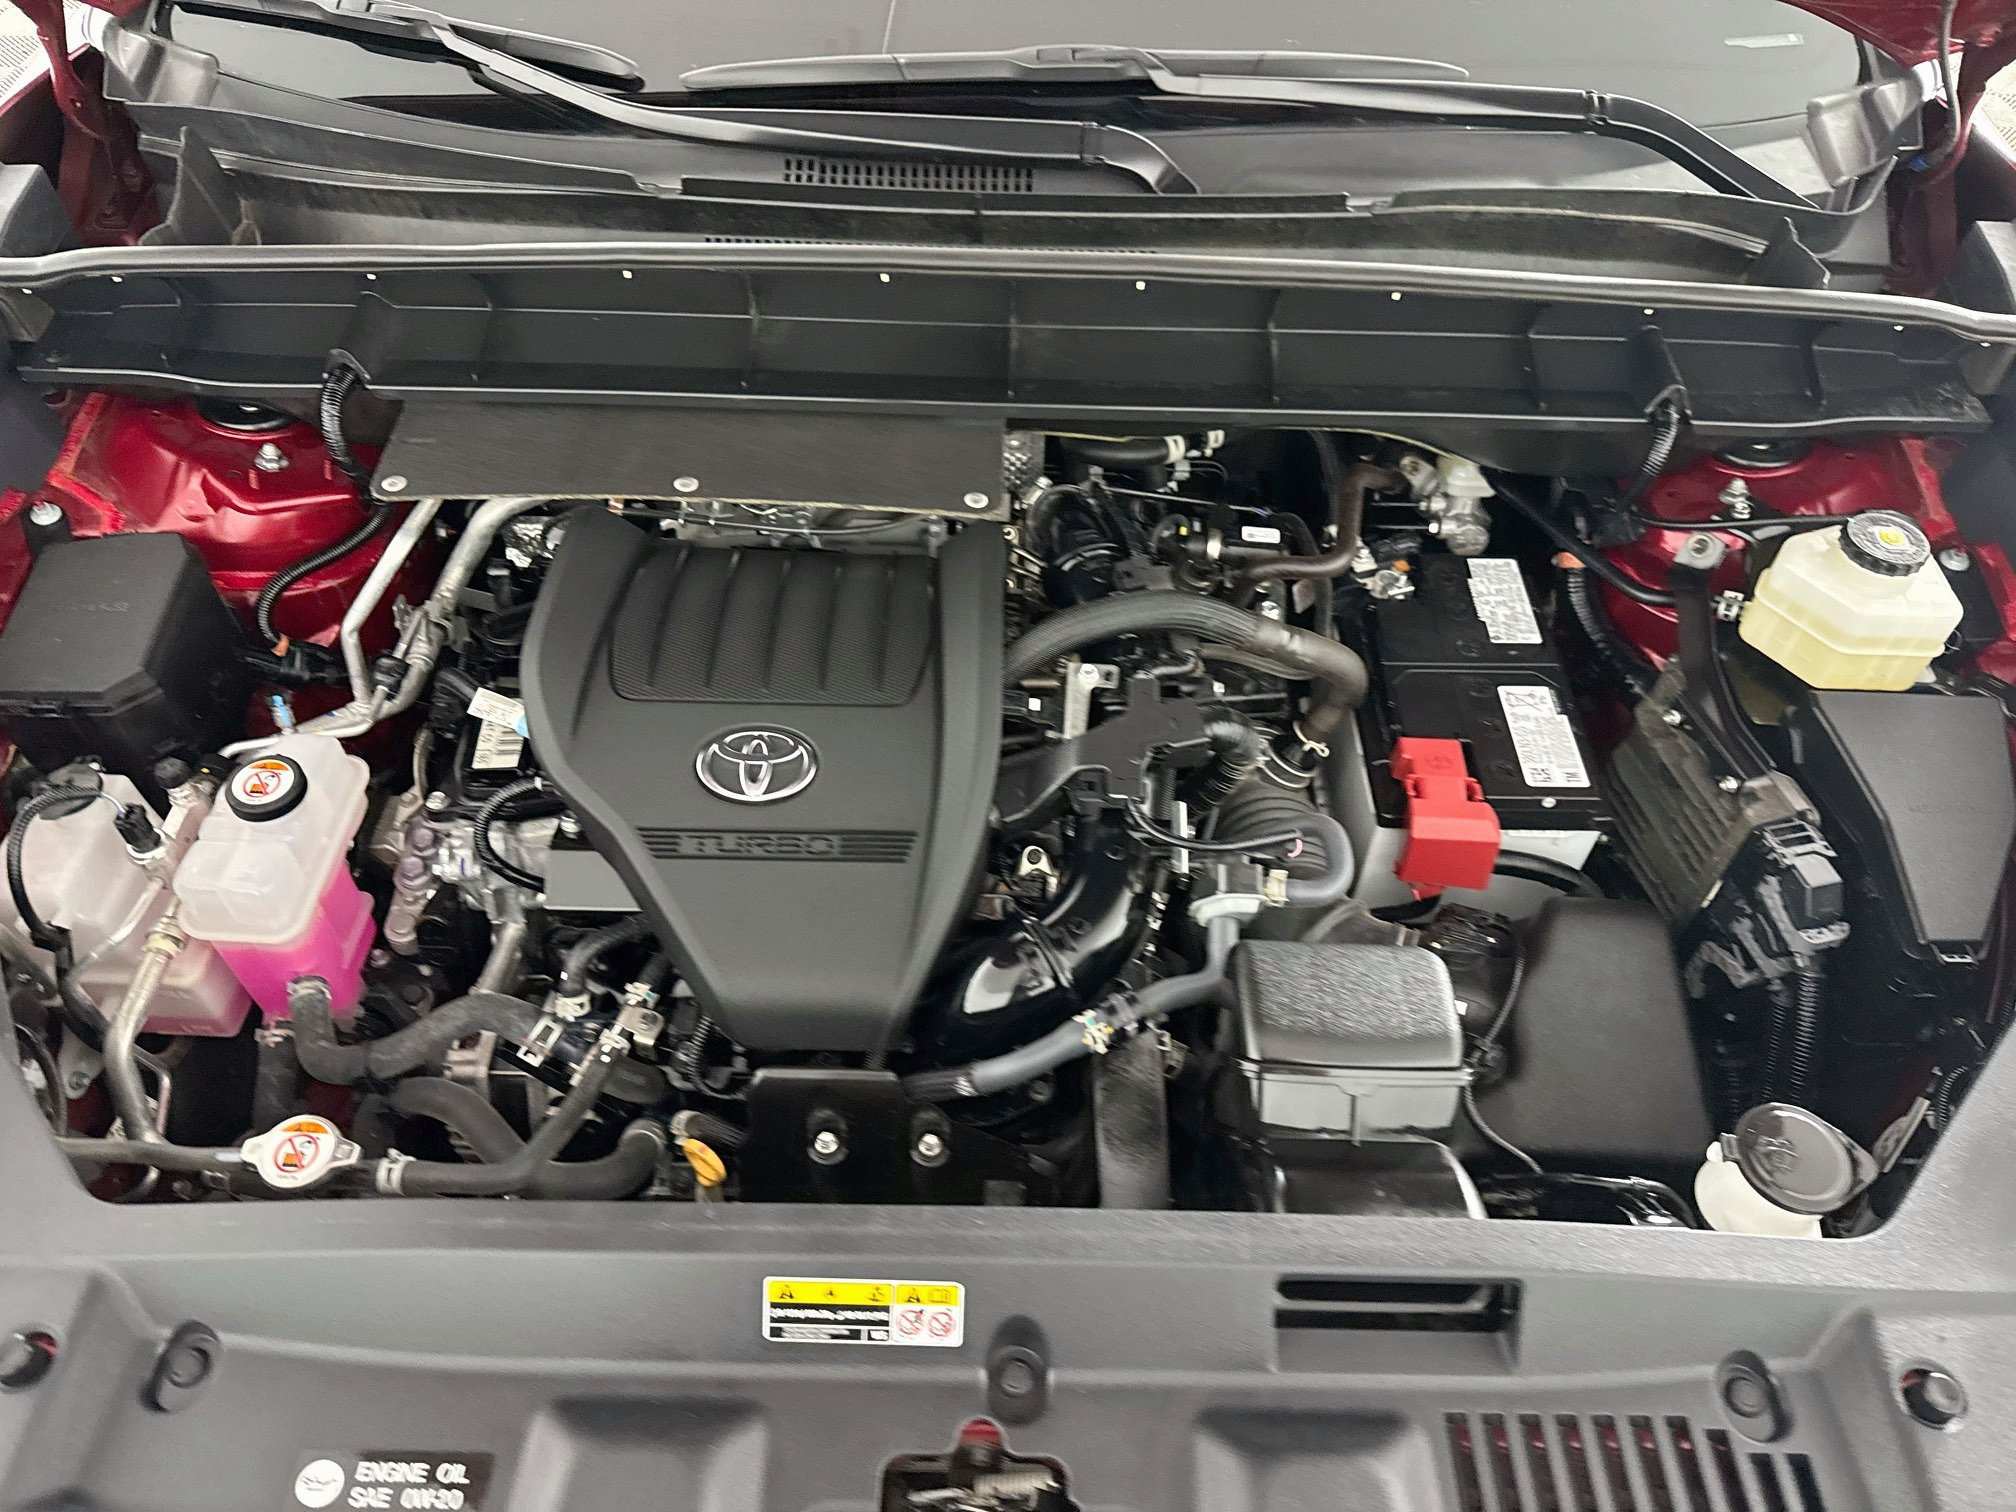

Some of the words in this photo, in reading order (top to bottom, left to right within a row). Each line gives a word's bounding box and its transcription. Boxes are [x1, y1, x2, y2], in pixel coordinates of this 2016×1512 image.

[683, 832, 837, 857] TURBO
[354, 1461, 431, 1483] ENGINE
[436, 1462, 470, 1484] OIL
[347, 1486, 394, 1508] SAE
